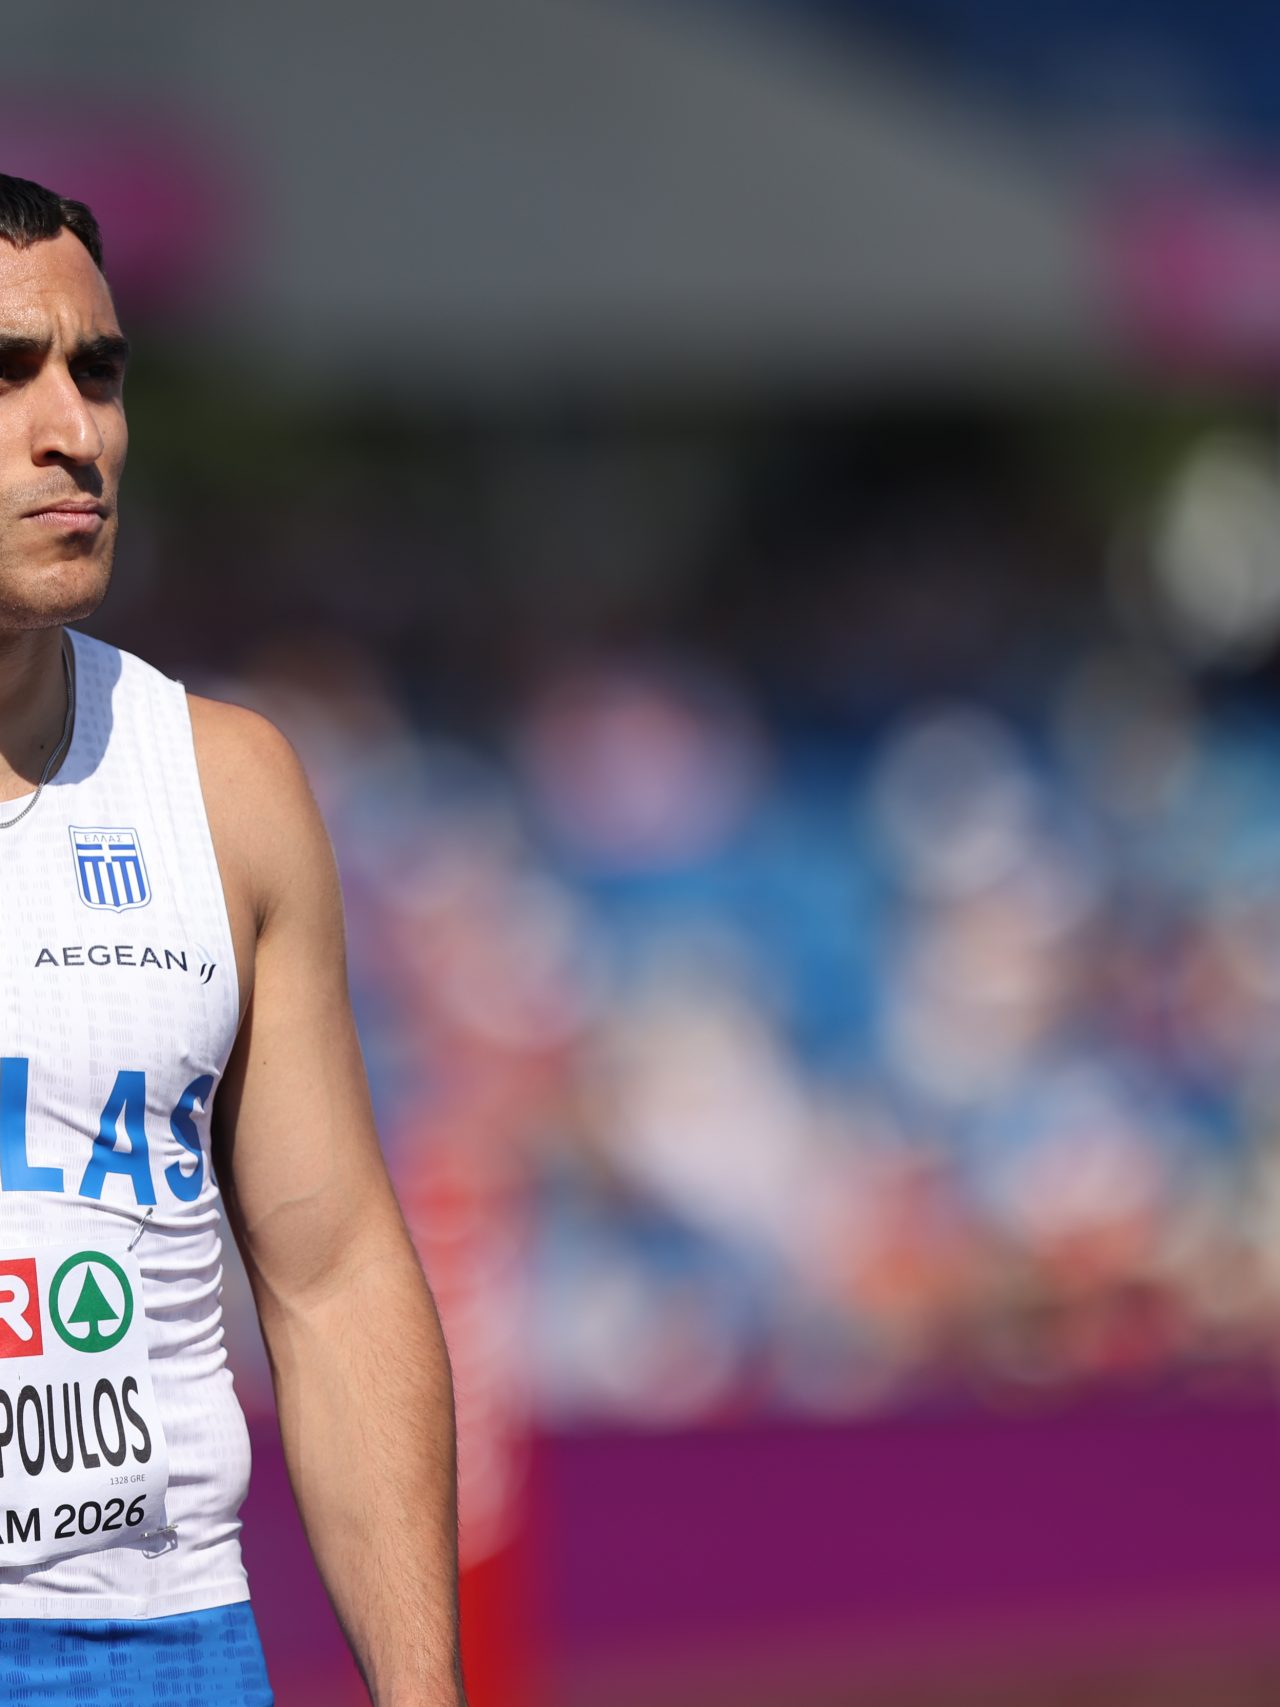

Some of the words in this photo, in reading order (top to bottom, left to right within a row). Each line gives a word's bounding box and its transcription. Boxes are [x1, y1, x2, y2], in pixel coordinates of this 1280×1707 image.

[84, 834, 123, 843] ΕΛΛΑΣ
[35, 945, 188, 971] AEGEAN
[110, 1476, 129, 1486] 1328
[130, 1474, 146, 1484] GRE
[55, 1495, 146, 1538] 2026
